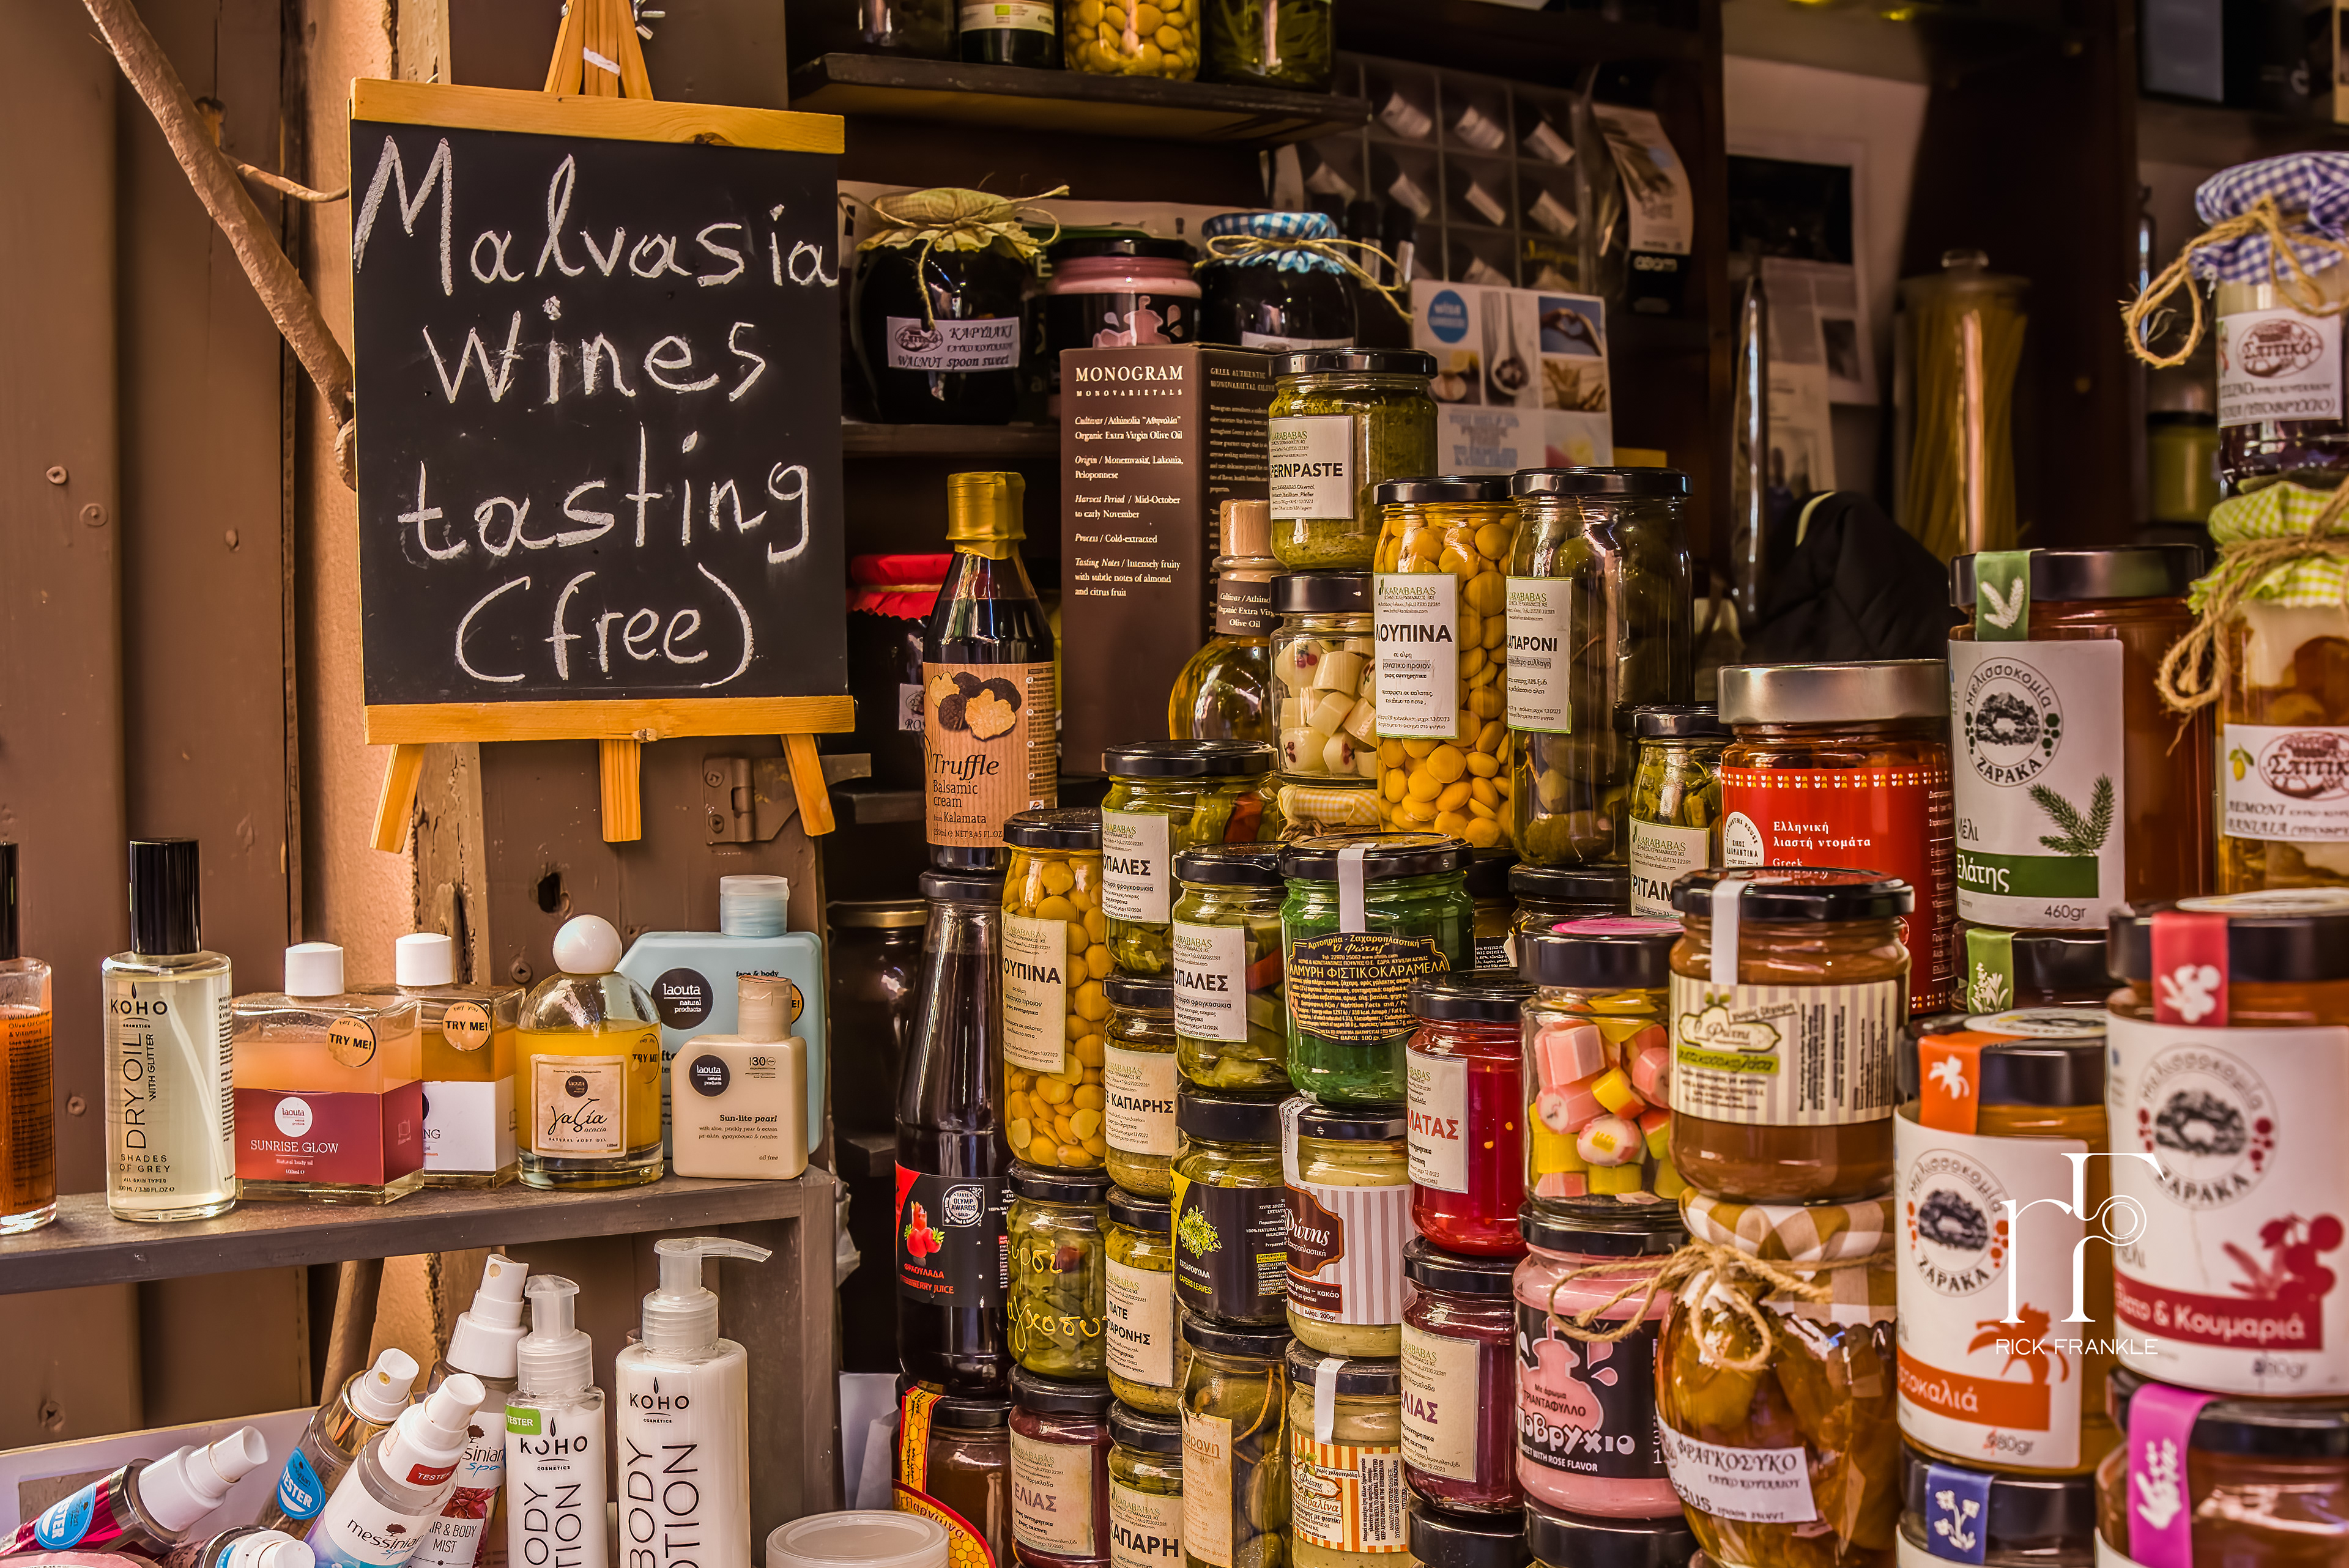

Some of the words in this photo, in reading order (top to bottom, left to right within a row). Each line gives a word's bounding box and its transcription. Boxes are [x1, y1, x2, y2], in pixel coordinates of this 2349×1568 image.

[354, 135, 839, 295] Malvasia
[946, 358, 979, 369] spoon
[1075, 366, 1183, 382] MONOGRAM
[1075, 431, 1103, 442] Organic
[1126, 431, 1148, 442] Virgin
[1171, 431, 1182, 439] Oil
[1075, 455, 1097, 466] Origin
[398, 421, 809, 564] tasting
[1084, 509, 1100, 519] early
[1104, 509, 1139, 518] November
[1075, 558, 1099, 568] Tasting
[1102, 558, 1119, 567] Notes
[1127, 560, 1159, 569] Intensely
[1161, 560, 1181, 571] fruity
[1143, 574, 1171, 583] almond
[1111, 588, 1126, 596] fruit
[1385, 586, 1436, 595] KARABABAS
[455, 563, 754, 688] (free)
[1376, 623, 1453, 642] ΛΟΥΠΙΝΑ
[932, 753, 1000, 780] Truffle
[1975, 756, 2043, 785] ΖΑΡΑΚΑ
[933, 780, 978, 795] Balsamic
[933, 796, 962, 807] cream
[944, 812, 986, 823] Kalamata
[1773, 821, 1828, 834] Ελληνική
[1773, 836, 1813, 849] λιαστή
[1818, 836, 1871, 849] ντομάτα
[2044, 903, 2087, 921] 460gr
[1350, 935, 1419, 948] Ζαχαροπλαστική
[1003, 958, 1061, 984] ΟΥΠΙΝΑ
[1290, 964, 1324, 978] ΑΛΜΥΡΗ
[1327, 960, 1446, 978] ΦΙΣΤΙΚΟΚΑΡΑΜΕΛΑ
[663, 983, 701, 996] laouta
[111, 999, 168, 1015] KOHO
[445, 1020, 466, 1031] TRY
[469, 1020, 488, 1032] ME!
[329, 1033, 350, 1045] TRY
[352, 1038, 372, 1050] ME!
[122, 1032, 143, 1082] OIL
[146, 1034, 157, 1073] GLITTER
[633, 1052, 649, 1063] TRY
[696, 1065, 721, 1074] laouta
[147, 1074, 157, 1102] WITH
[1111, 1092, 1173, 1114] ΚΑΠΑΡΗΣ
[124, 1087, 147, 1149] DRY
[281, 1108, 305, 1117] laouta
[548, 1098, 607, 1135] γαζία
[754, 1115, 777, 1123] pearl
[250, 1139, 299, 1153] SUNRISE
[302, 1142, 339, 1155] GLOW
[120, 1153, 167, 1163] SHADES
[119, 1163, 132, 1172] OF
[1917, 1256, 1991, 1293] ΖΑΡΑΚΑ
[933, 1284, 954, 1294] JUICE
[1193, 1282, 1212, 1295] LEAVES
[1317, 1290, 1340, 1298] κακάο
[1109, 1300, 1128, 1320] ΠΑΤΕ
[2153, 1301, 2169, 1327] &
[2174, 1304, 2306, 1343] Κουμαριά
[629, 1392, 690, 1410] KOHO
[506, 1415, 533, 1427] TESTER
[520, 1435, 588, 1455] KOHO
[1548, 1455, 1565, 1467] ROSE
[1567, 1459, 1598, 1472] FLAVOR
[1677, 1438, 1797, 1474] ΦΡΑΓΚΟΣΥΚΟ
[418, 1471, 451, 1481] TESTER
[465, 1462, 501, 1479] spa
[1015, 1481, 1056, 1512] ΕΛΙΑΣ
[661, 1443, 701, 1568] TION
[1321, 1515, 1341, 1524] φιστίκι
[443, 1523, 451, 1536] &
[452, 1523, 477, 1538] BODY
[432, 1539, 458, 1553] MIST
